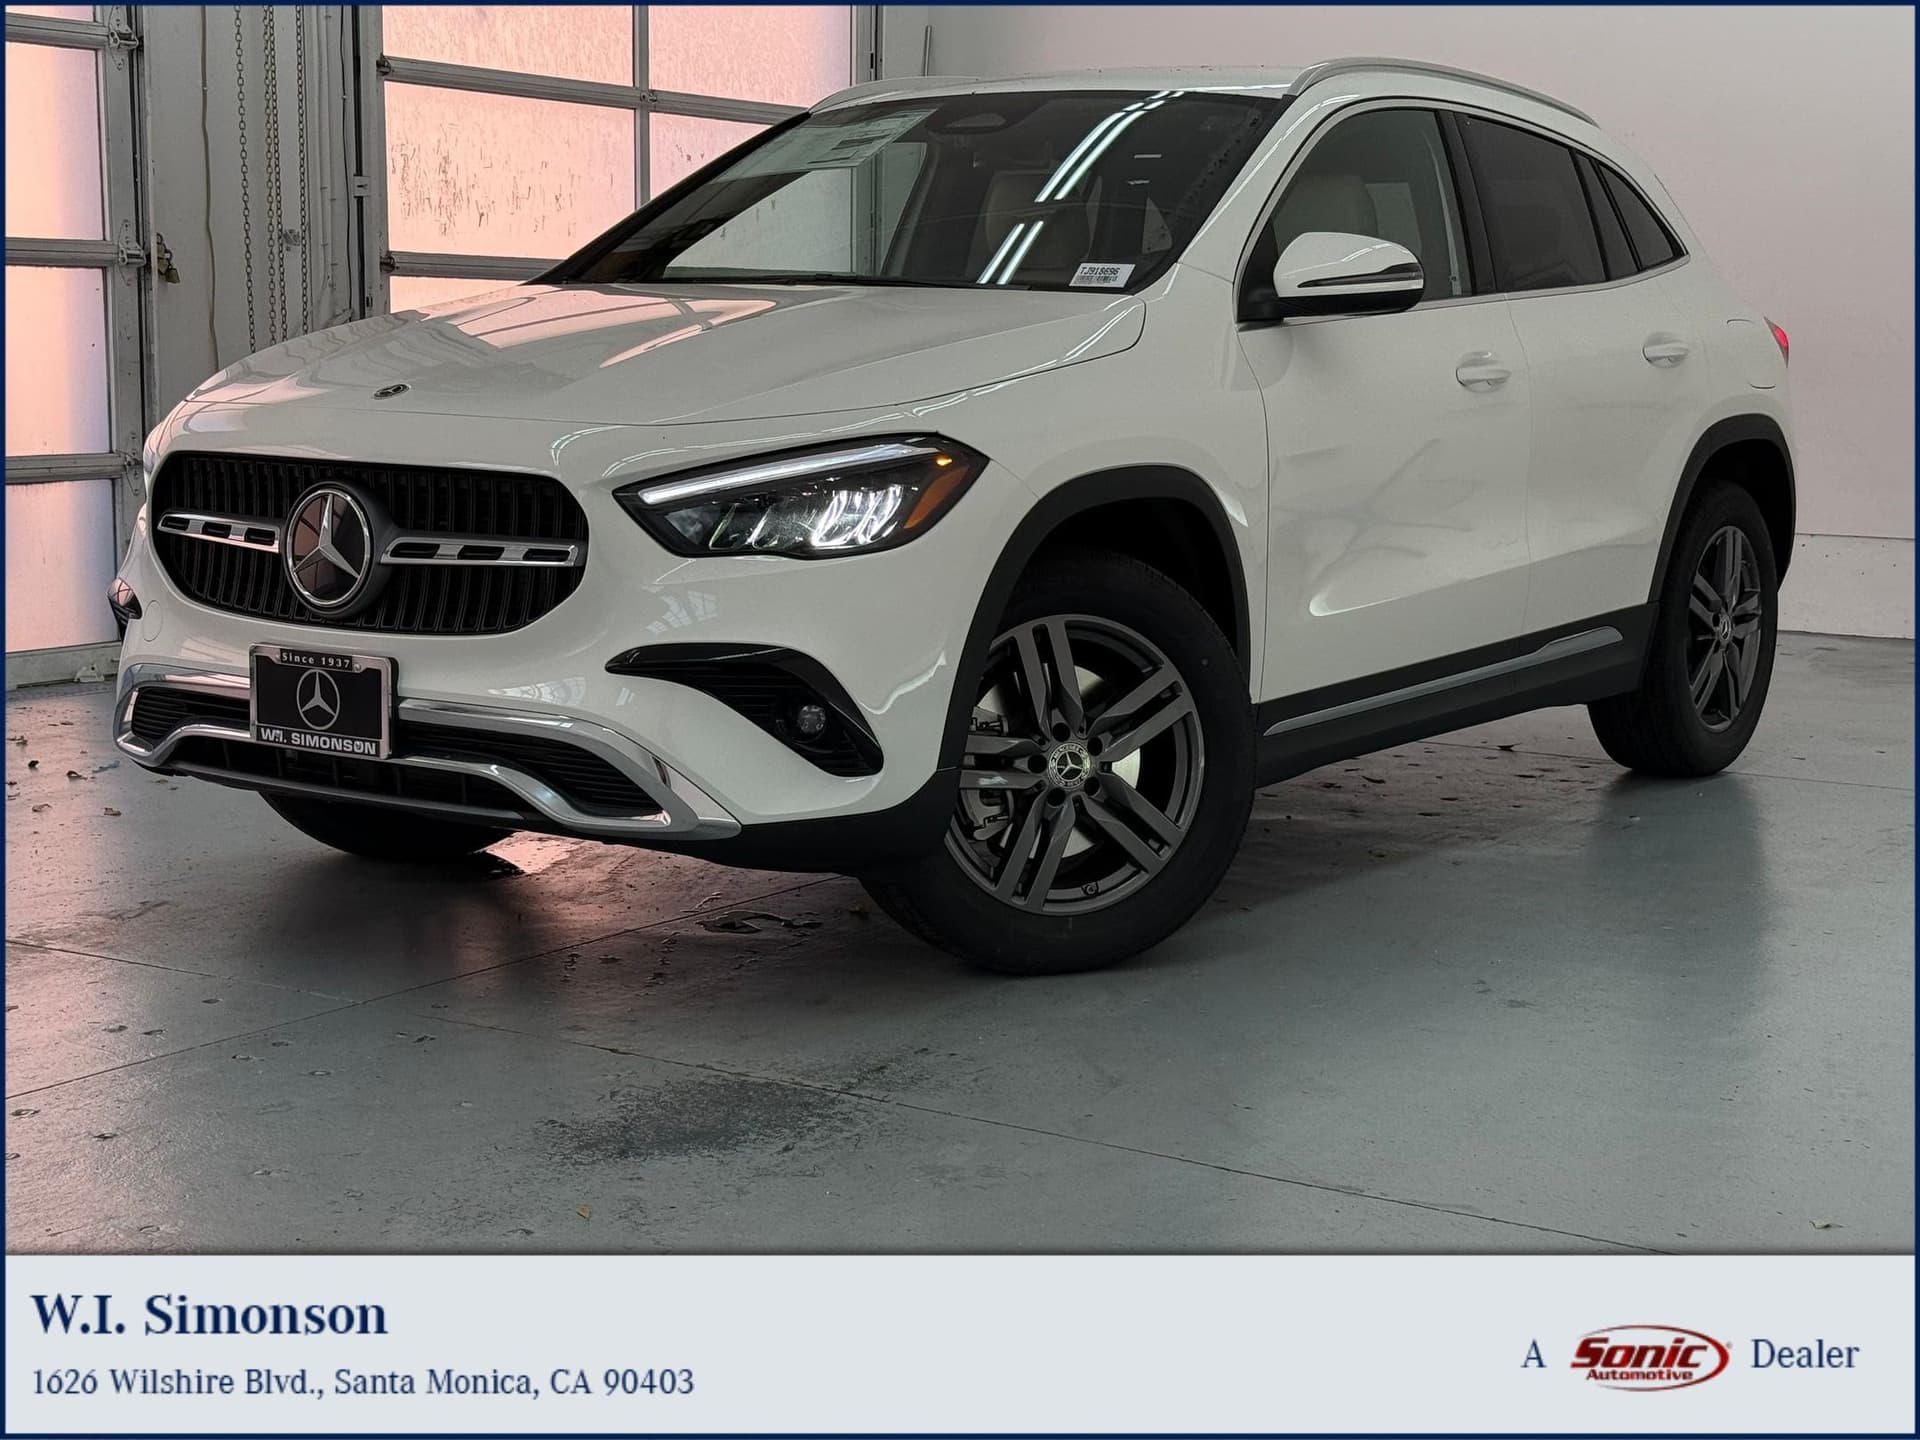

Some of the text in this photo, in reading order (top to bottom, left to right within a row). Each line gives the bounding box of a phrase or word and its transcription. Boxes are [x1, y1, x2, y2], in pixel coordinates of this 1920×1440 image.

[281, 652, 350, 668] Since 1937
[291, 732, 377, 755] SIMONSON
